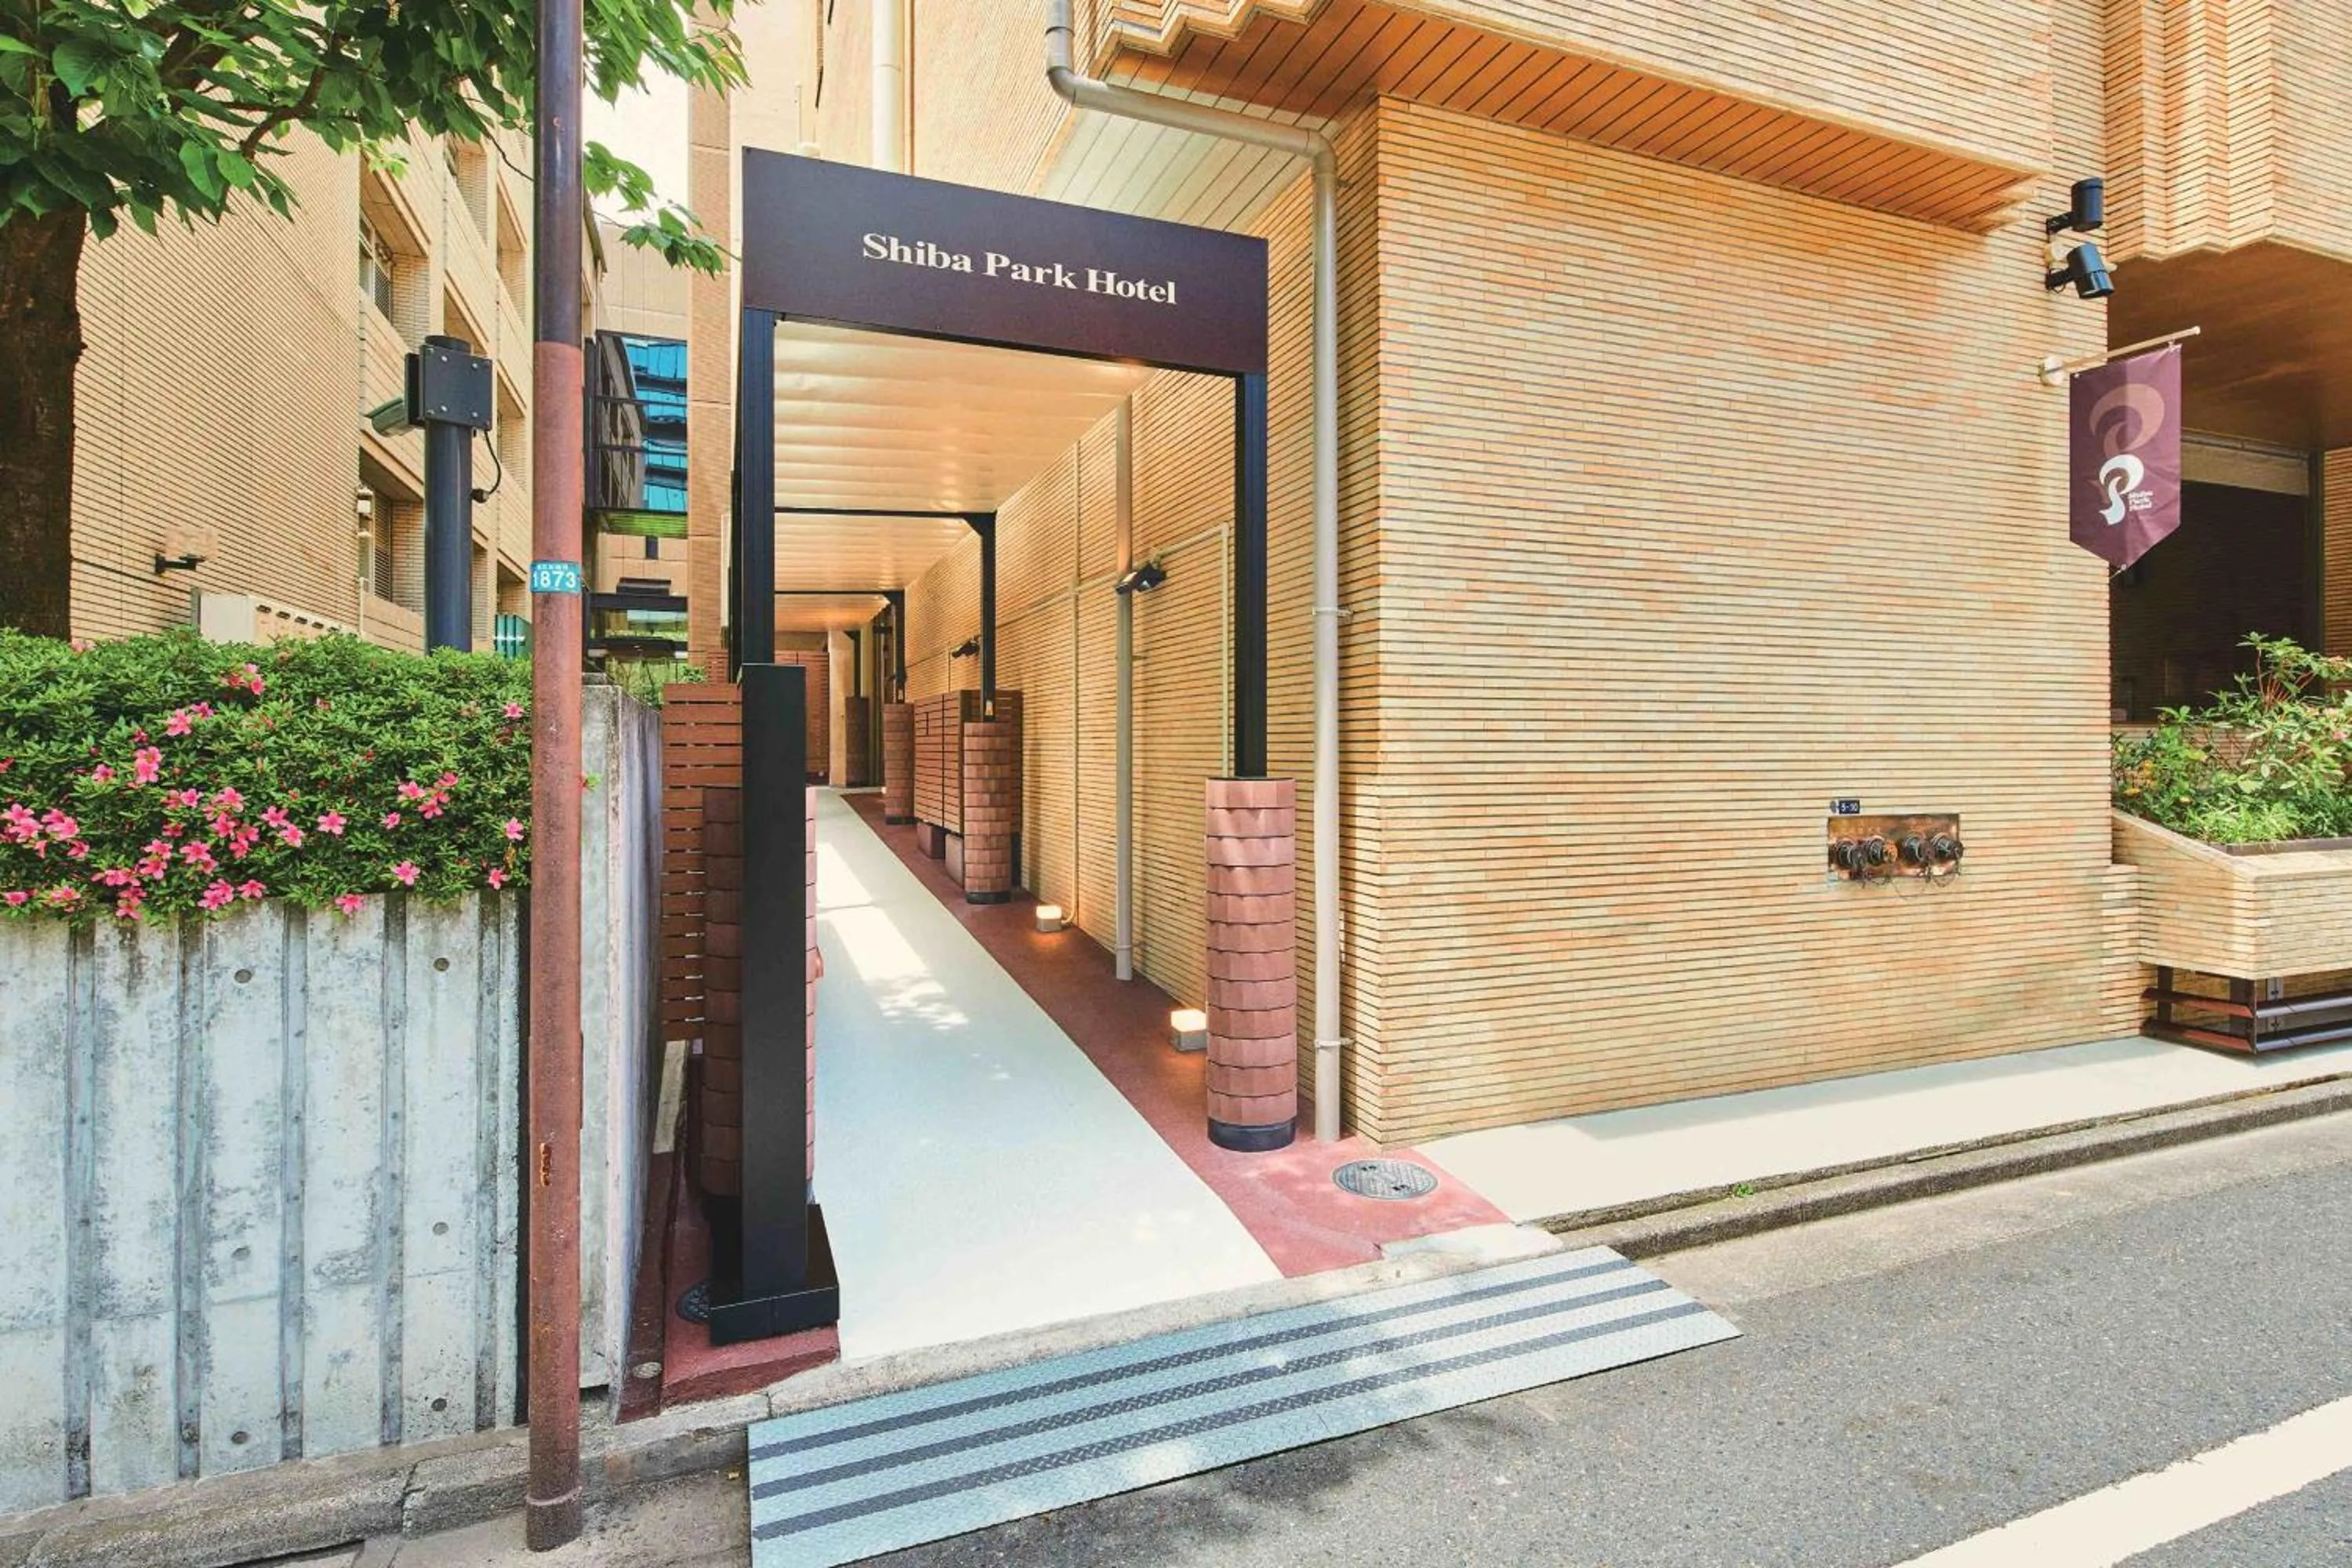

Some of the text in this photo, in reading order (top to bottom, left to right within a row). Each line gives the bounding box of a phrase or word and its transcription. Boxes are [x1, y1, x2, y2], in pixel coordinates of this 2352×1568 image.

[862, 233, 1178, 305] Shiba Park Hotel
[532, 570, 576, 589] 1873
